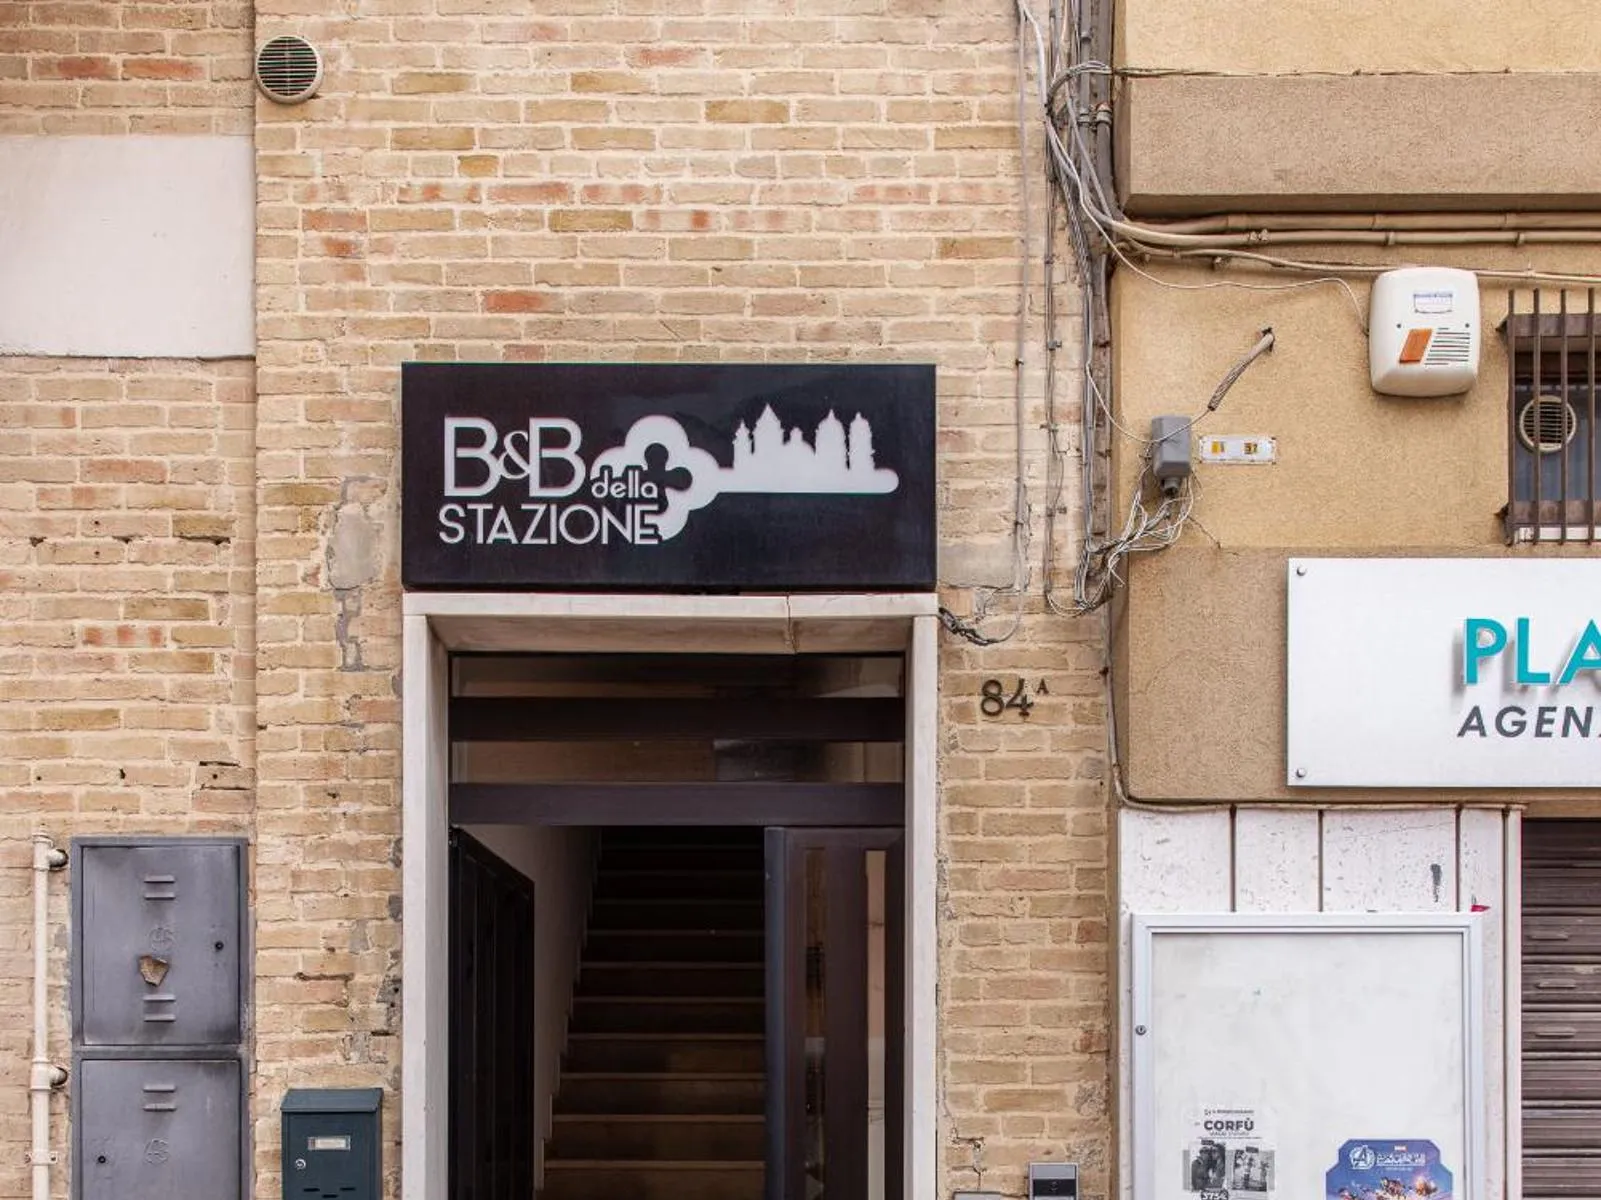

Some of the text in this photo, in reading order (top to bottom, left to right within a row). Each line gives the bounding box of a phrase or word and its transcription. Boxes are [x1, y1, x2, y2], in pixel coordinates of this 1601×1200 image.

[444, 416, 658, 499] B&B della
[439, 503, 659, 545] STAZIONE
[1457, 705, 1601, 738] AGEN
